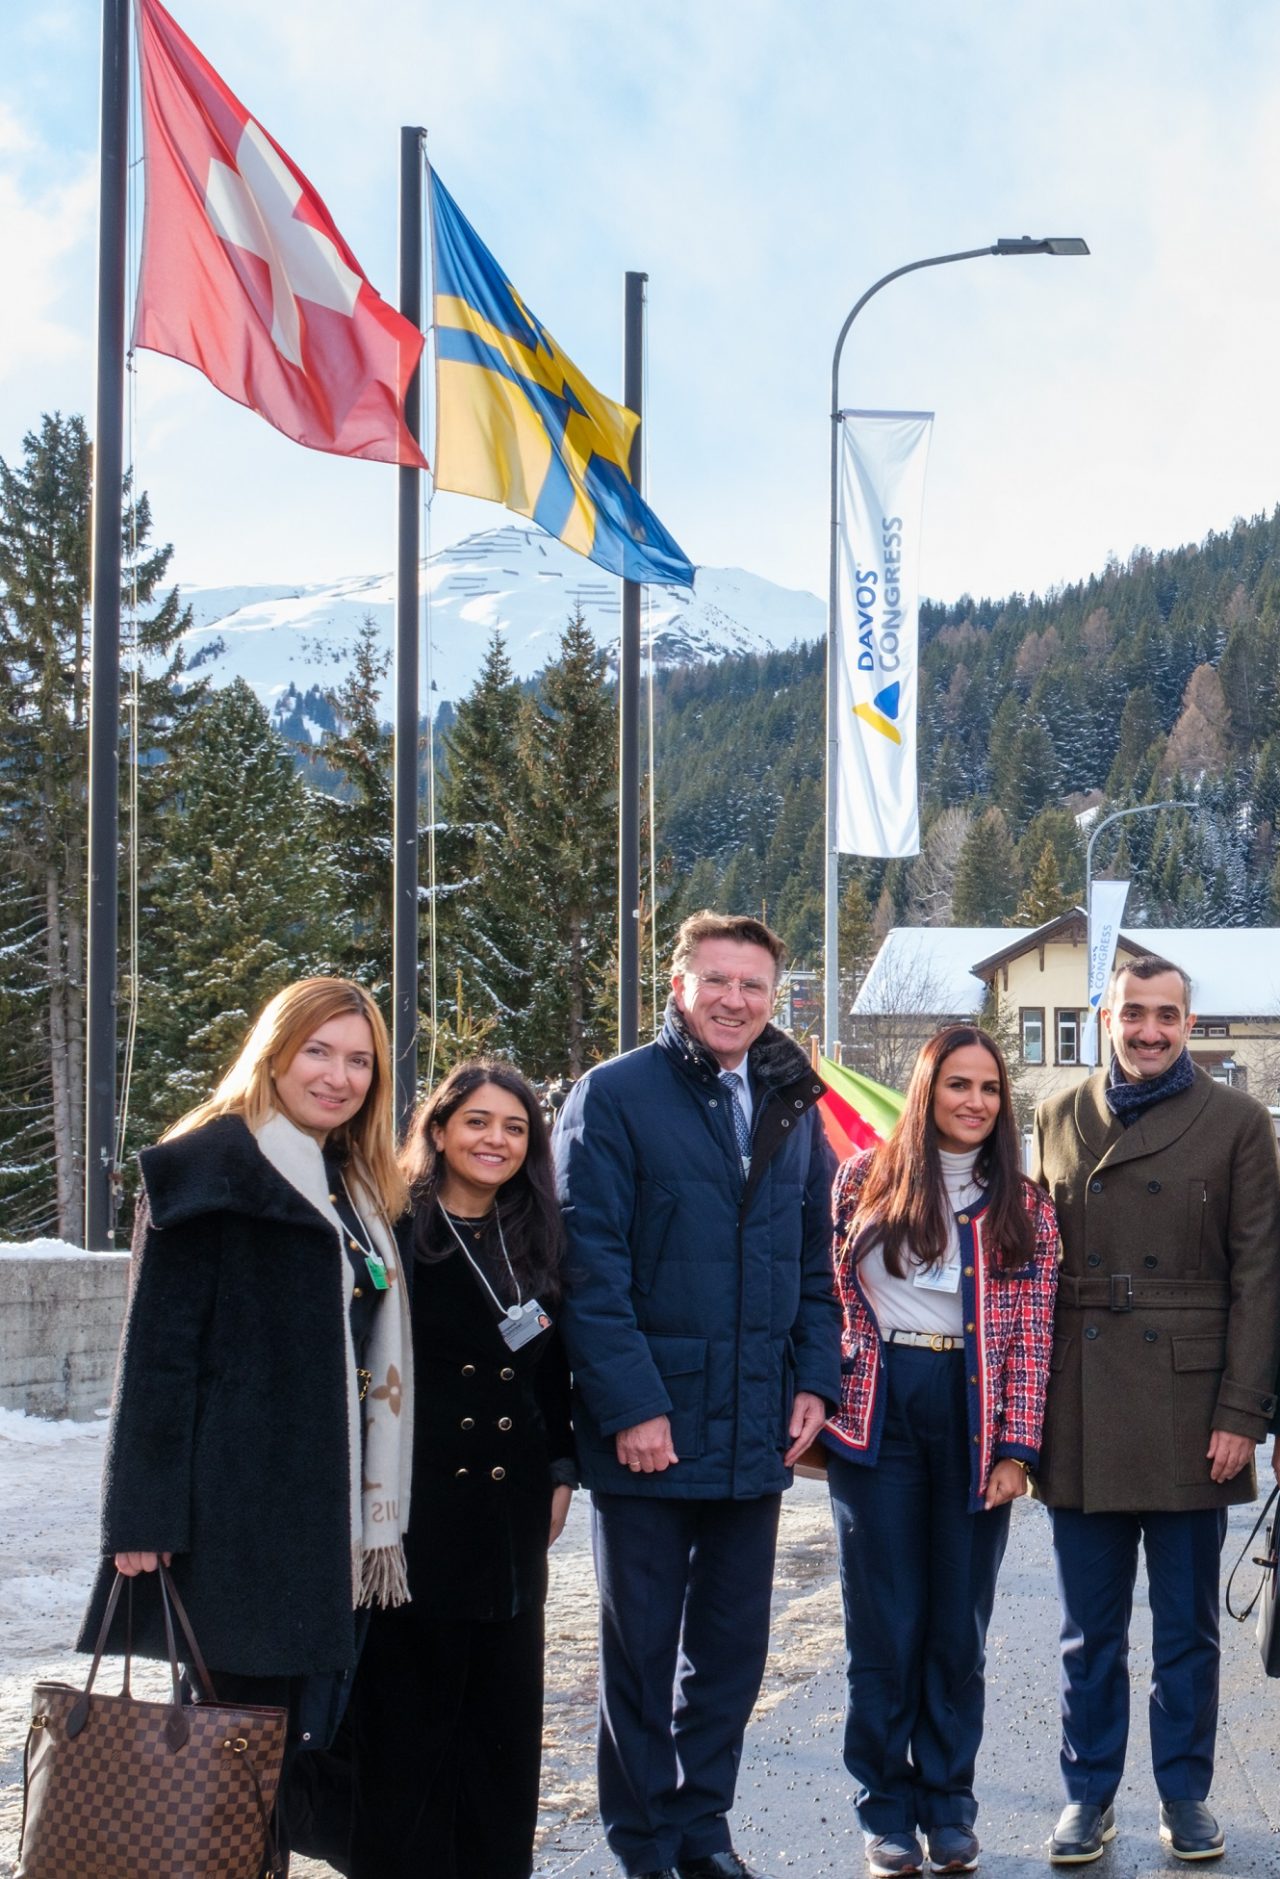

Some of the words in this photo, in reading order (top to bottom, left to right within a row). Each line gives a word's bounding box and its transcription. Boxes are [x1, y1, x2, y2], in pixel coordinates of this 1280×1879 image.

[855, 570, 879, 671] DAVOS
[878, 516, 903, 673] CONGRESS
[1095, 925, 1112, 989] CONGRESS
